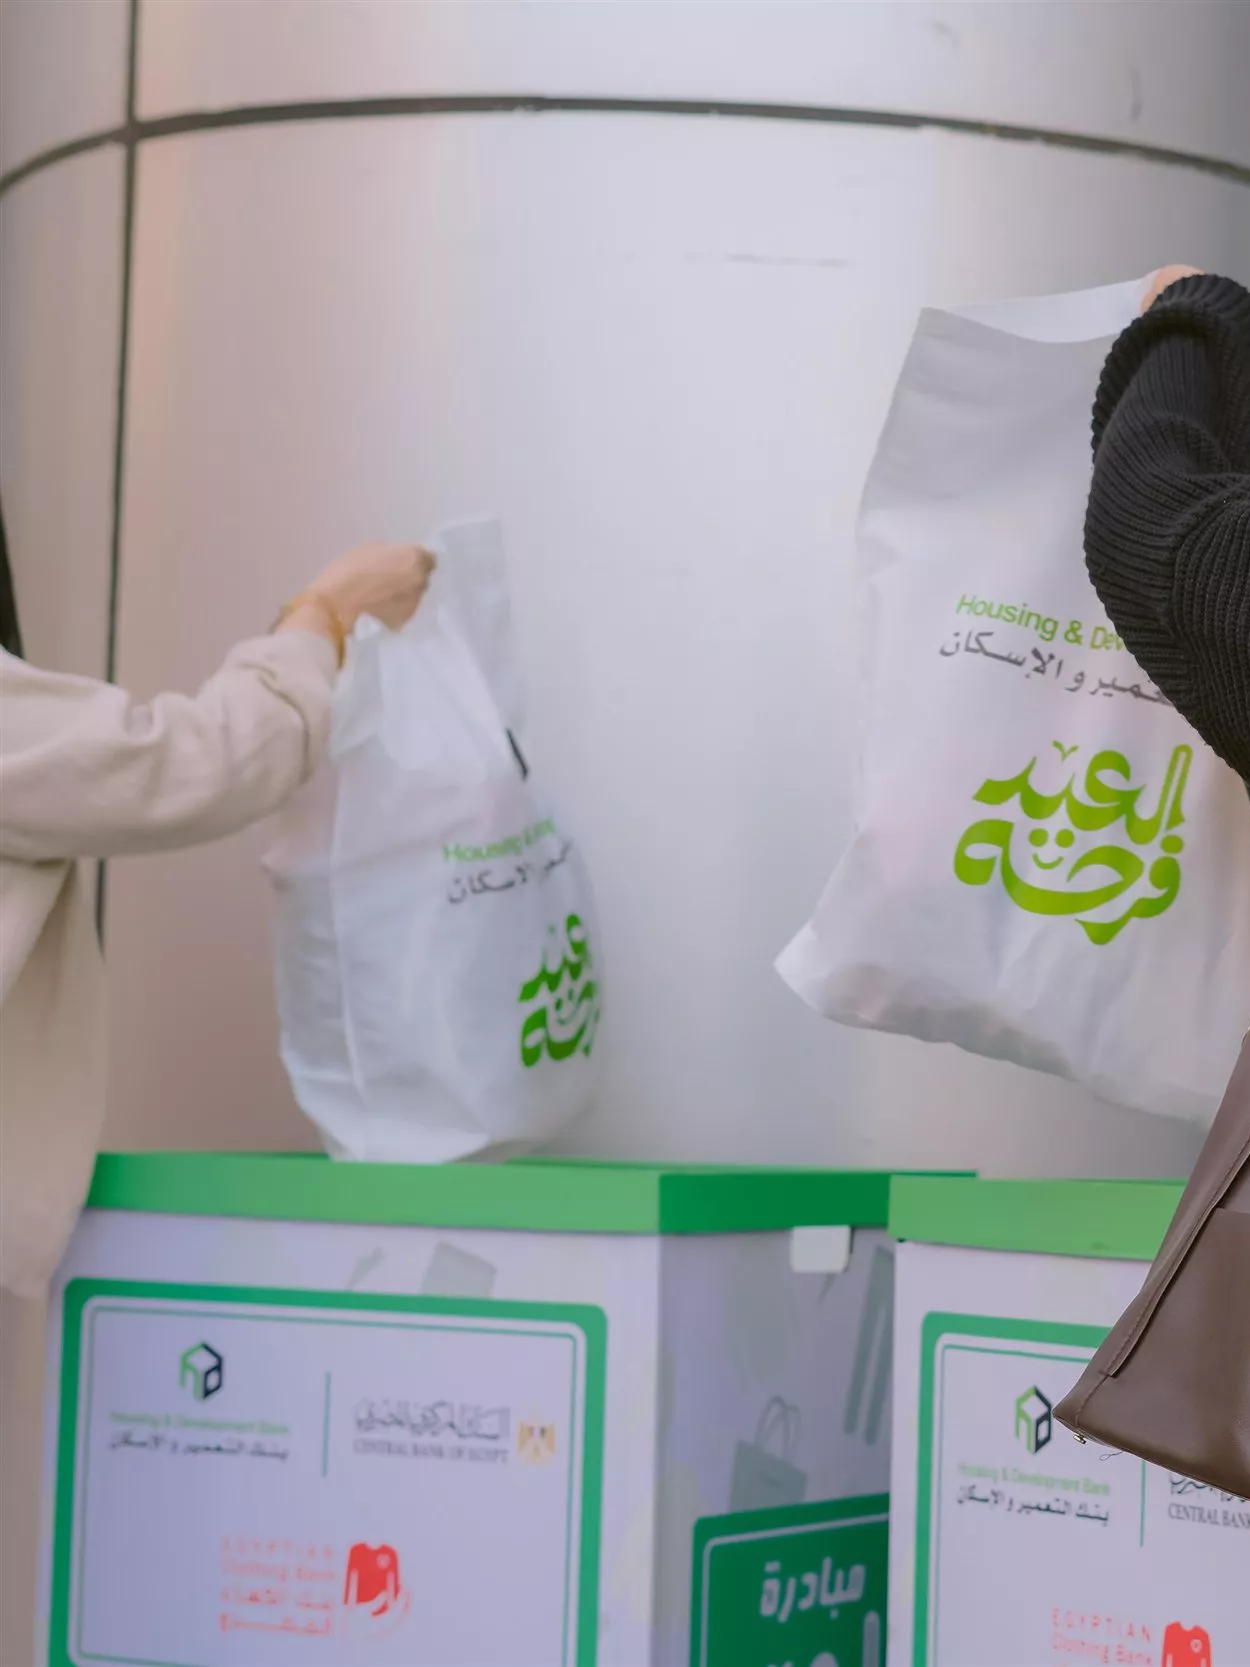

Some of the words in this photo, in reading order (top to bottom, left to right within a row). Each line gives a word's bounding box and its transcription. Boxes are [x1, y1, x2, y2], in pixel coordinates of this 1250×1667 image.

[956, 594, 1059, 642] Housing
[1064, 620, 1083, 645] &
[1089, 626, 1126, 651] Dev
[972, 740, 1193, 845] العيد
[1168, 1503, 1219, 1526] CENTRAL
[759, 1556, 866, 1624] مبادرة
[1052, 1606, 1152, 1643] EGYPTIAN
